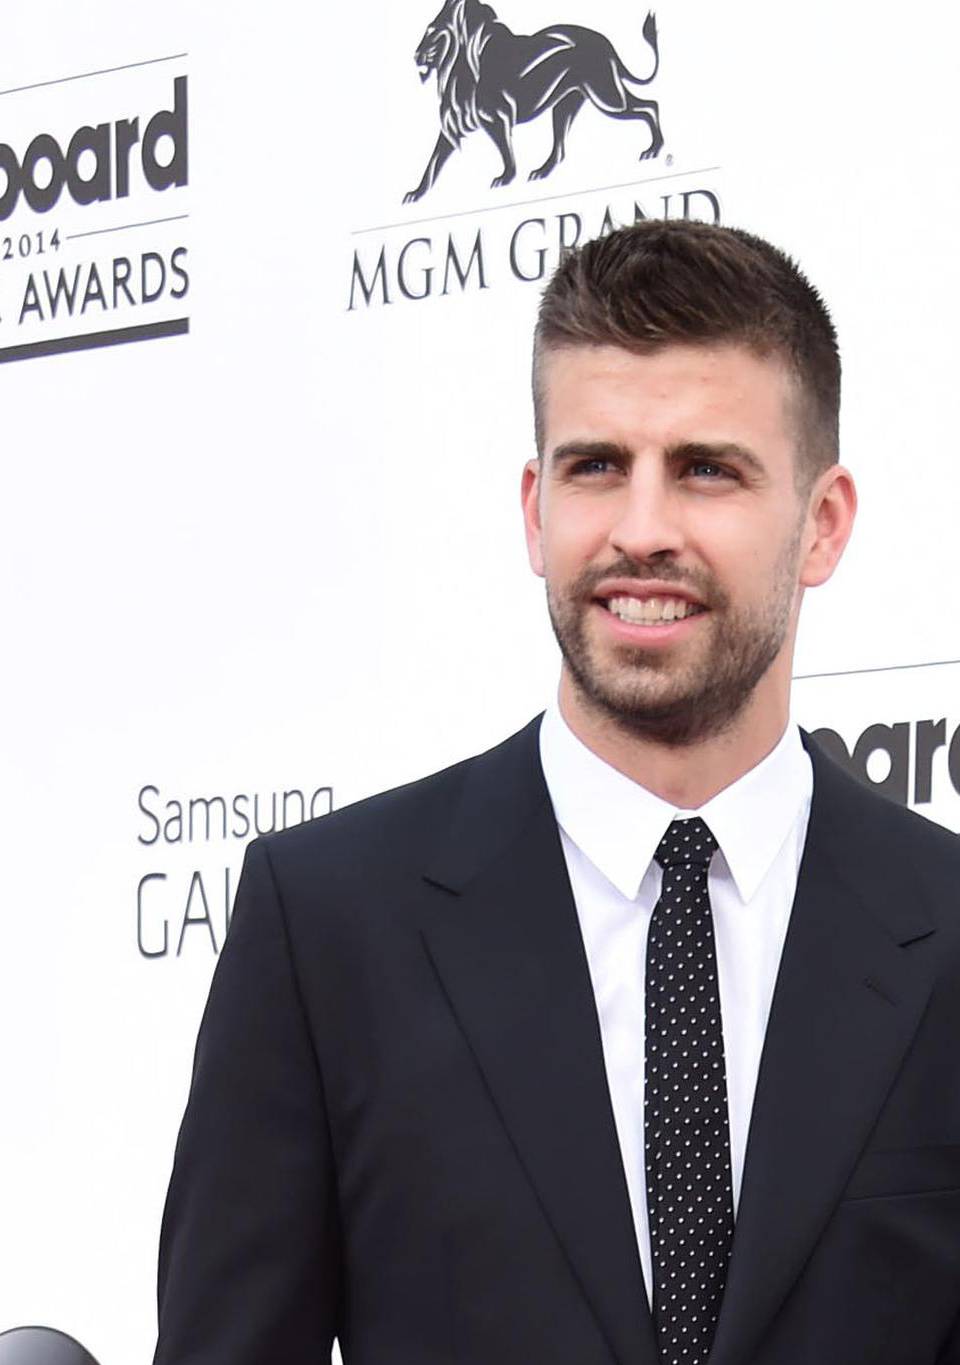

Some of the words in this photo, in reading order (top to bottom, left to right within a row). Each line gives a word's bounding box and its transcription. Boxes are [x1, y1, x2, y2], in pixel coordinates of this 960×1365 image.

[2, 228, 61, 261] 2014
[346, 227, 489, 312] MGM
[19, 246, 190, 325] AWARDS
